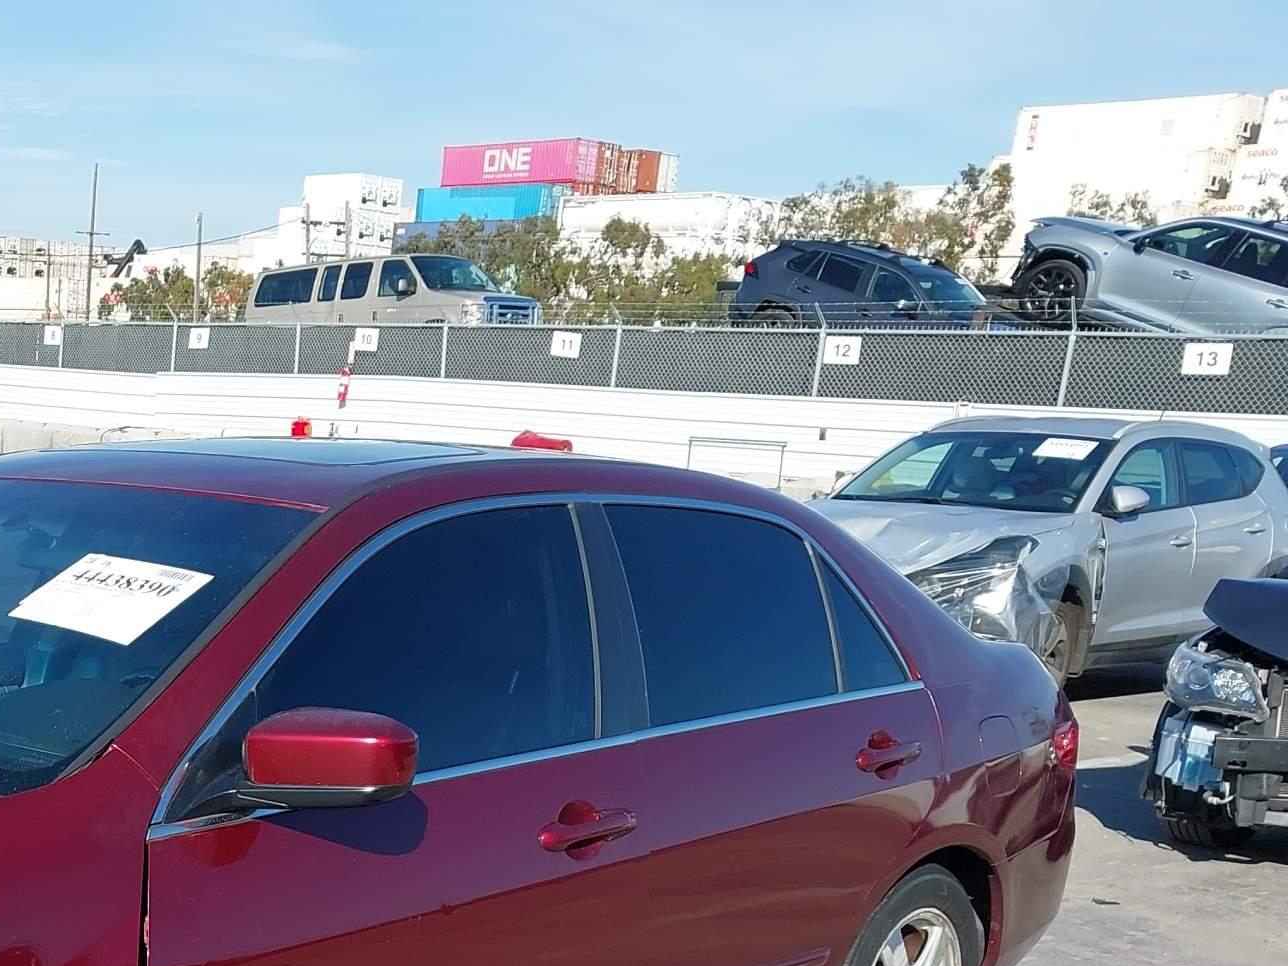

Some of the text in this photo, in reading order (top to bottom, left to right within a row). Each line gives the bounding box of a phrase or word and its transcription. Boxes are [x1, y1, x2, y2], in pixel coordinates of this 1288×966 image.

[1247, 148, 1279, 158] seaco
[483, 147, 532, 173] ONE
[196, 332, 203, 344] 9
[361, 334, 372, 345] 10
[561, 339, 573, 351] 11
[834, 344, 851, 357] 12
[1196, 351, 1218, 367] 13
[72, 568, 172, 598] 44438390
